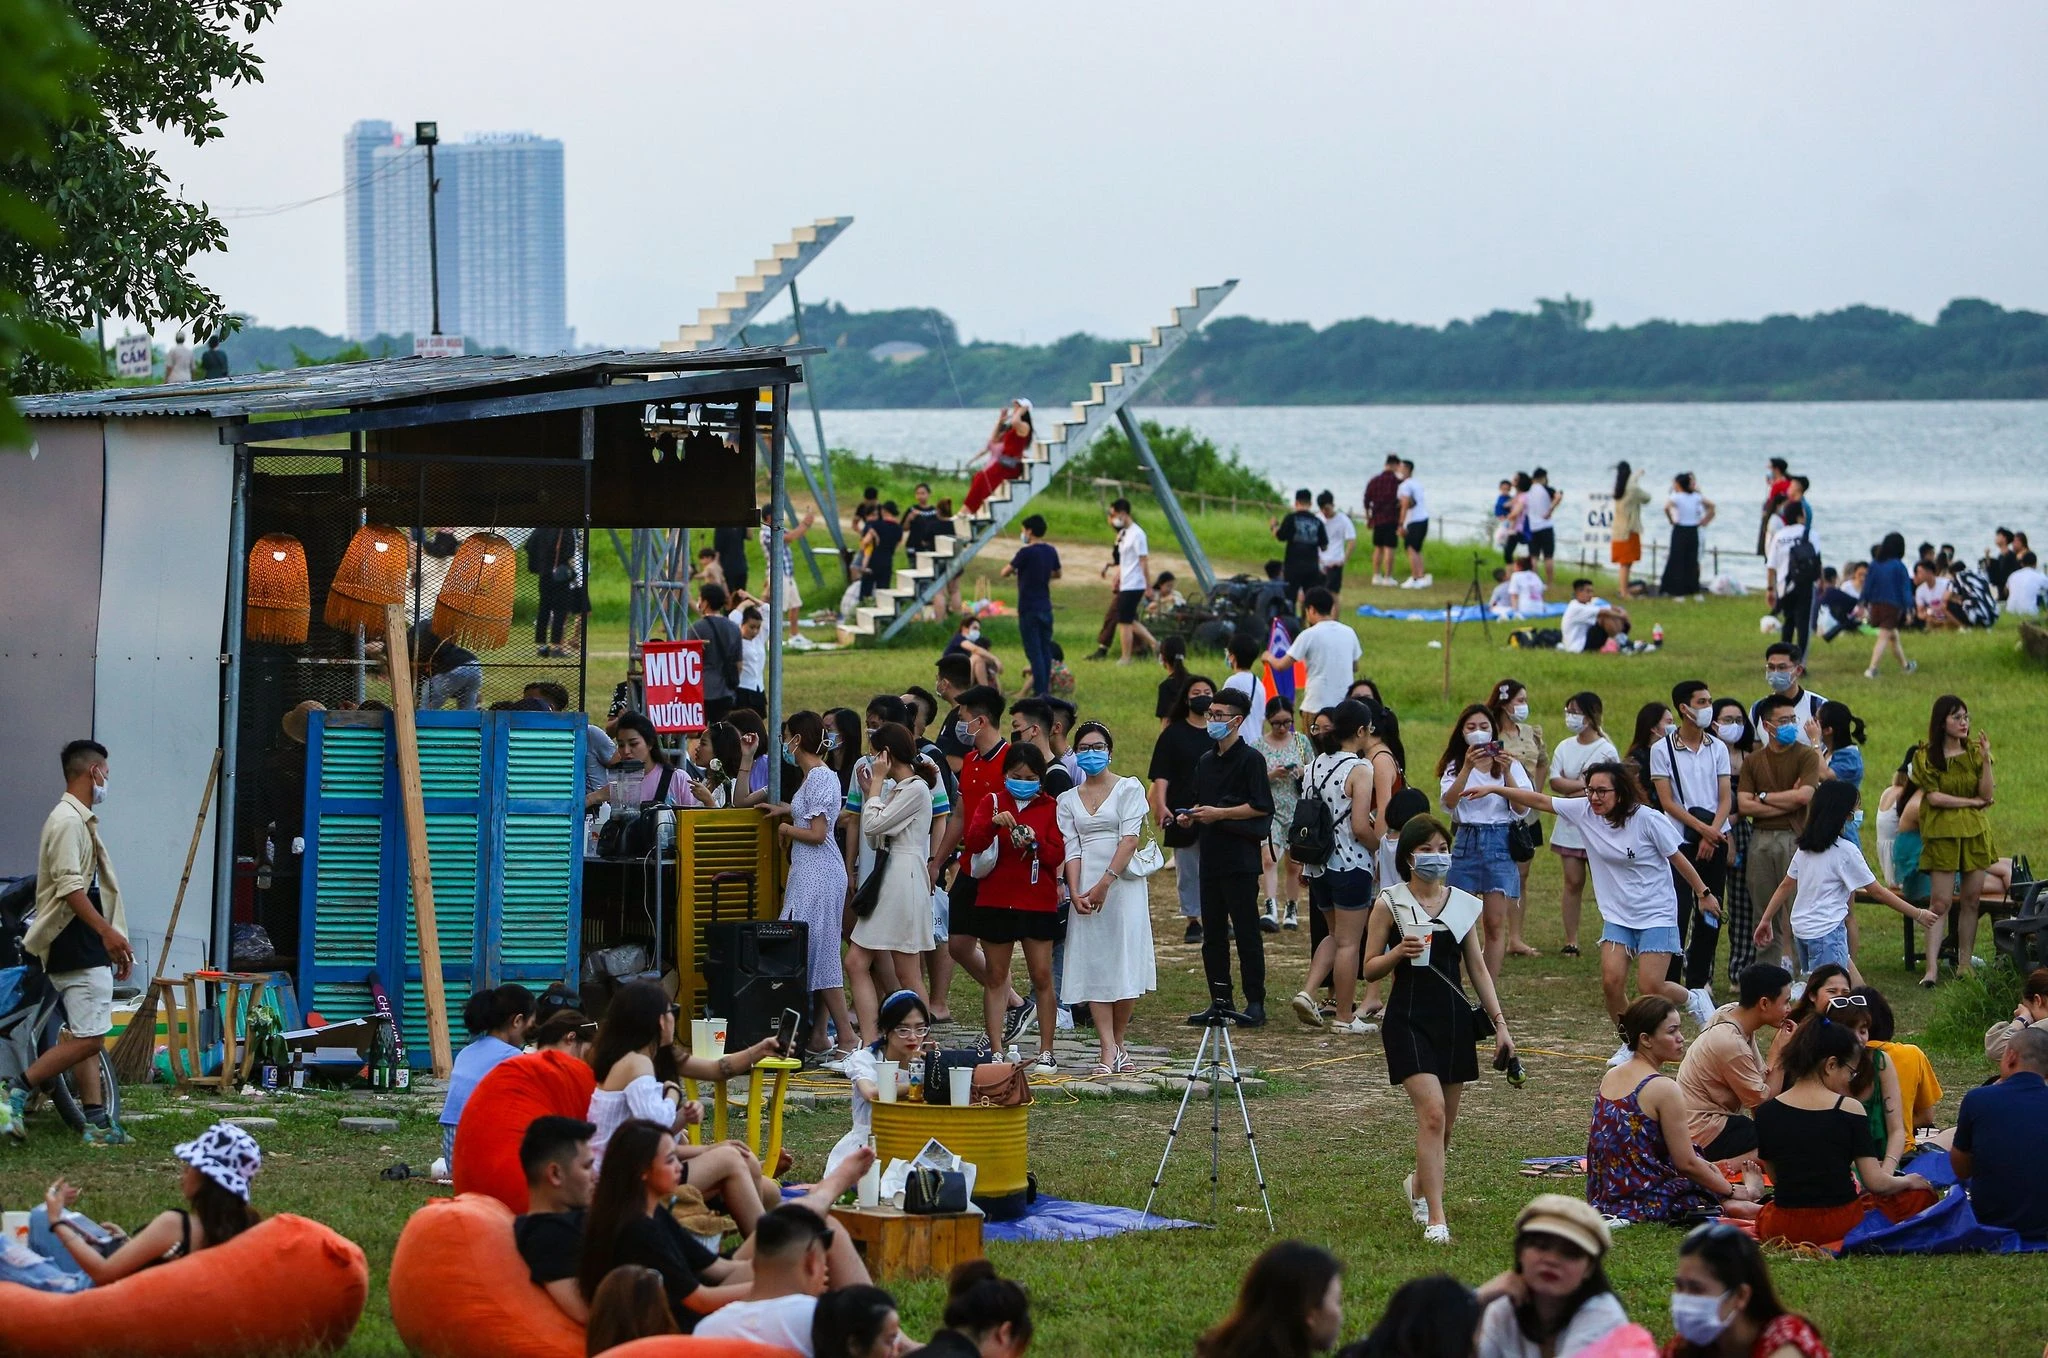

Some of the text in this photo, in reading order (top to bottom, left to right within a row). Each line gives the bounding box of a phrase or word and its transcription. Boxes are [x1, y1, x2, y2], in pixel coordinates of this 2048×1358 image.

[120, 345, 147, 364] CẤM
[1588, 502, 1614, 527] CẤ
[645, 648, 701, 693] MỰC
[649, 697, 704, 727] NƯỚNG
